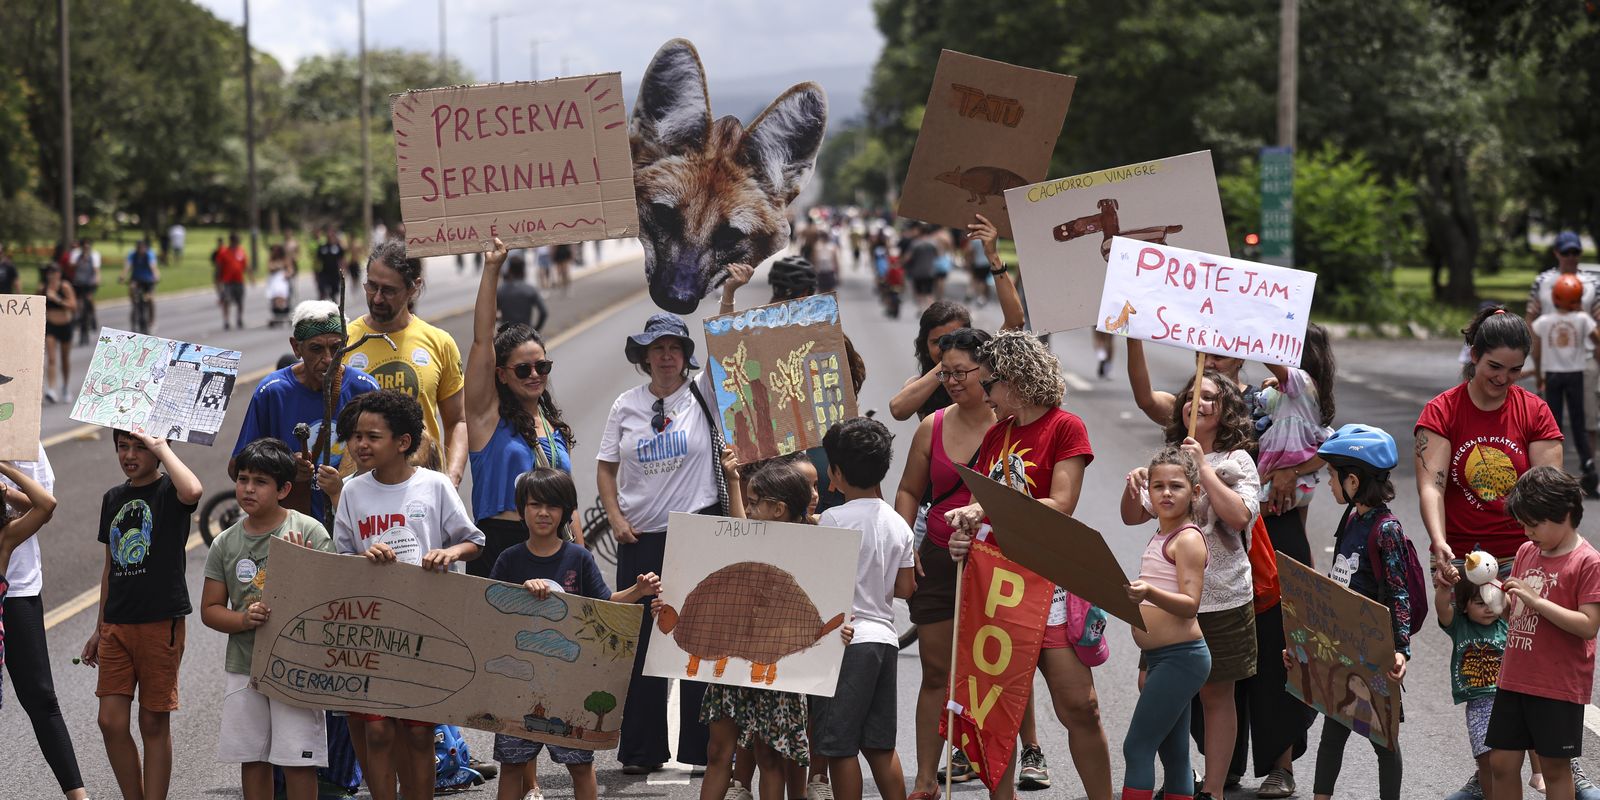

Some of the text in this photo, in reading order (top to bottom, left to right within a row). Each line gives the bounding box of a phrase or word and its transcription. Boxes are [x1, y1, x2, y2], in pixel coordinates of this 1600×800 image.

[951, 83, 1024, 128] TATU
[431, 99, 584, 148] PRESERVA
[1027, 165, 1157, 203] CACHORRO VINAGRE
[435, 223, 479, 243] ÁGUA
[490, 217, 498, 237] É
[1199, 297, 1214, 314] A
[1452, 440, 1477, 466] PRECISA
[714, 520, 768, 537] JABUTI
[322, 600, 384, 621] SALVE
[290, 619, 424, 657] A SERRINHA!
[324, 648, 380, 670] SALVE
